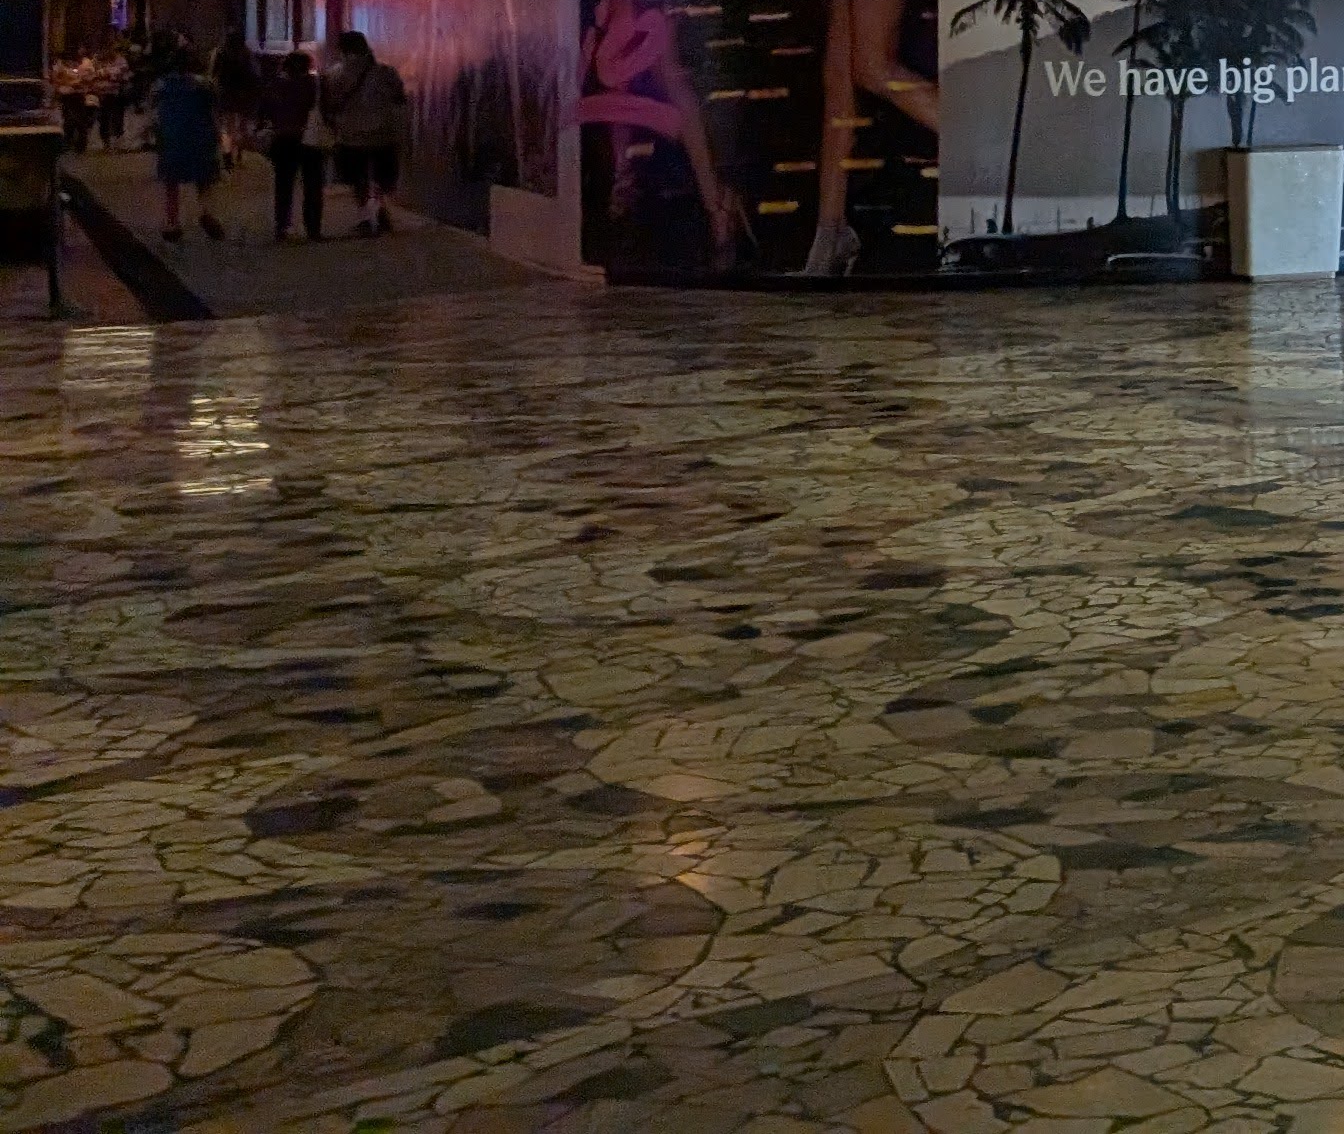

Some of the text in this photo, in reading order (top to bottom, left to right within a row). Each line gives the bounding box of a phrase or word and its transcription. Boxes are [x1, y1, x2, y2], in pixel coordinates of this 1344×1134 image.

[1044, 60, 1107, 97] We
[1118, 59, 1209, 96] have
[1219, 57, 1276, 104] big
